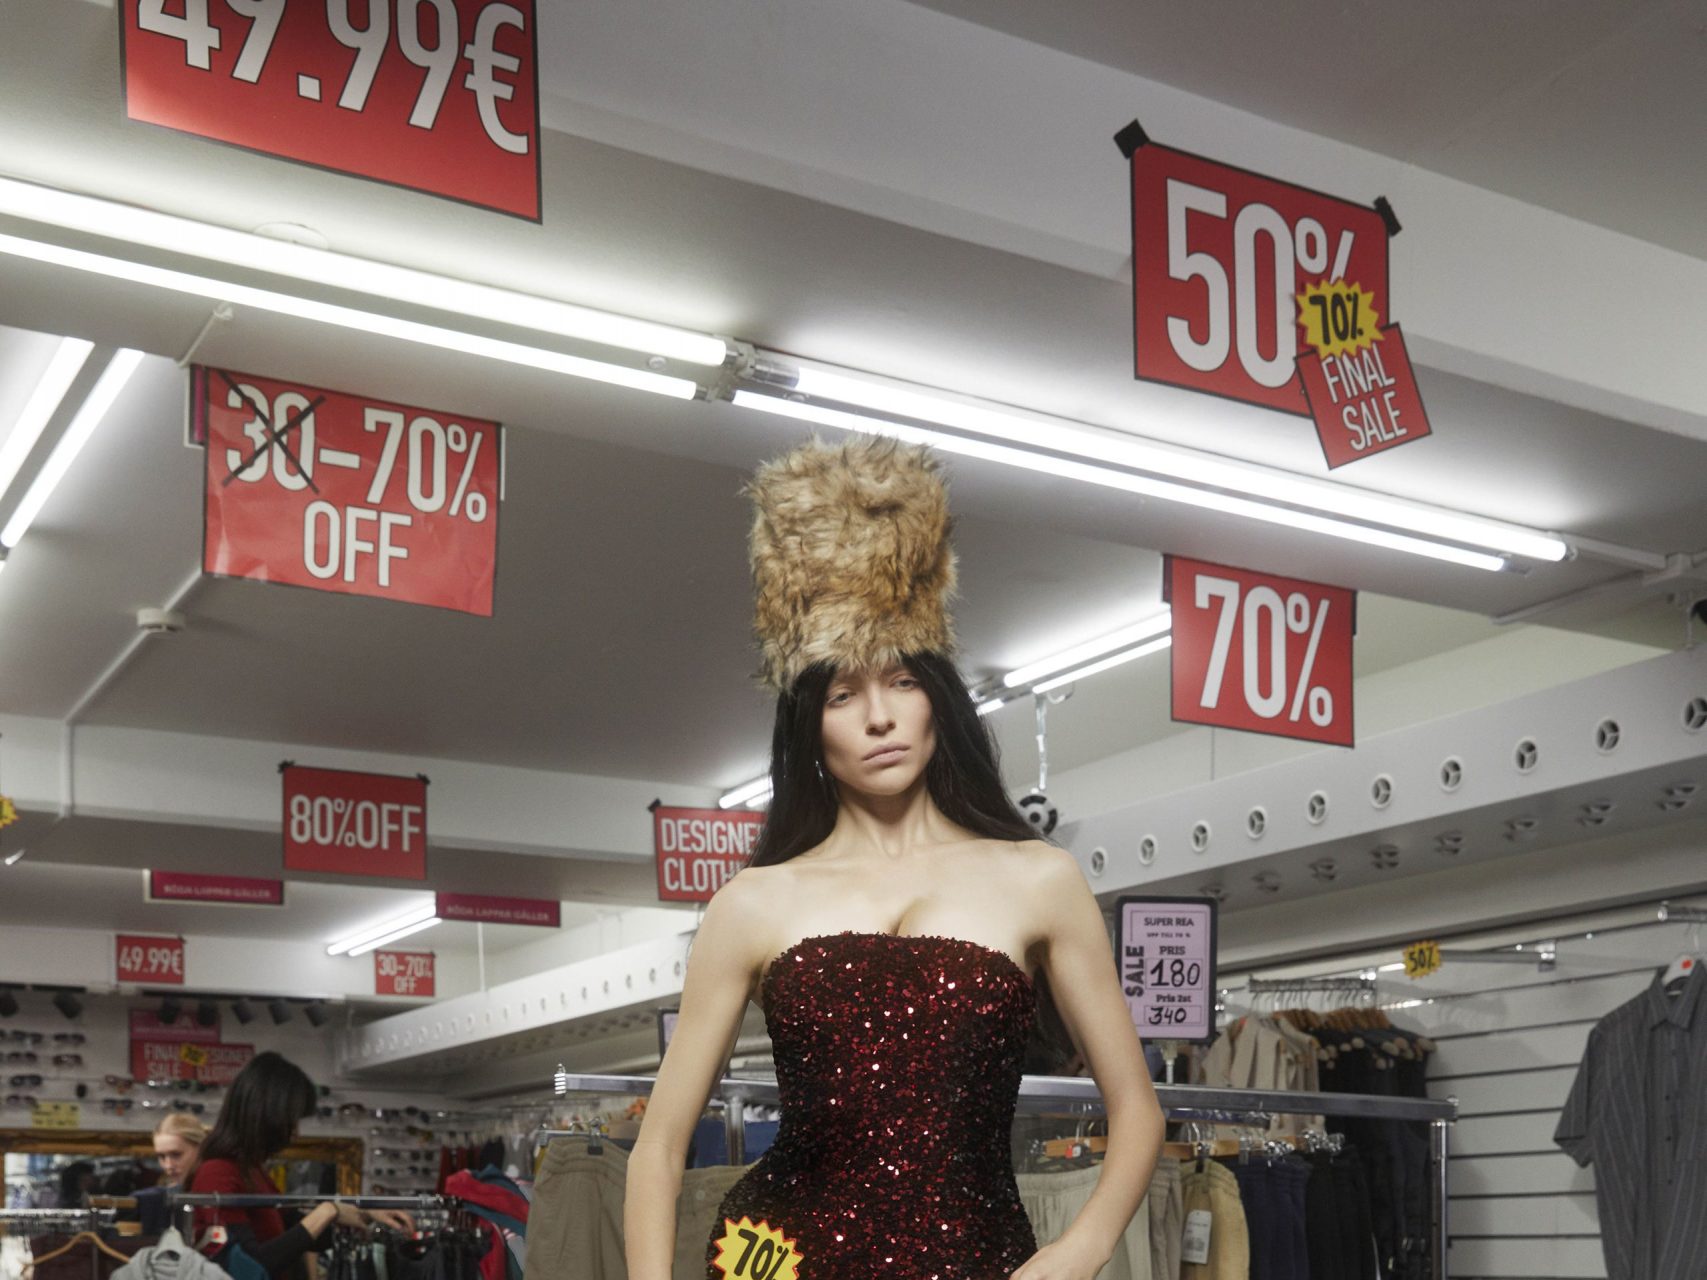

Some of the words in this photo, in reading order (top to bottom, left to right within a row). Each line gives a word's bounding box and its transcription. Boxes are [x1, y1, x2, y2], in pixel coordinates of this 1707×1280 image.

[1309, 292, 1364, 346] 70%
[1321, 343, 1396, 403] FINAL
[1342, 391, 1408, 450] SALE
[304, 500, 412, 587] OFF
[1195, 574, 1334, 728] 70%
[661, 818, 765, 854] DESIGNE
[1144, 917, 1173, 927] SUPER
[1175, 917, 1194, 927] REA
[1125, 946, 1144, 997] SALE
[1150, 957, 1200, 988] 180
[1159, 946, 1186, 956] PRIS
[1148, 1006, 1187, 1025] 340
